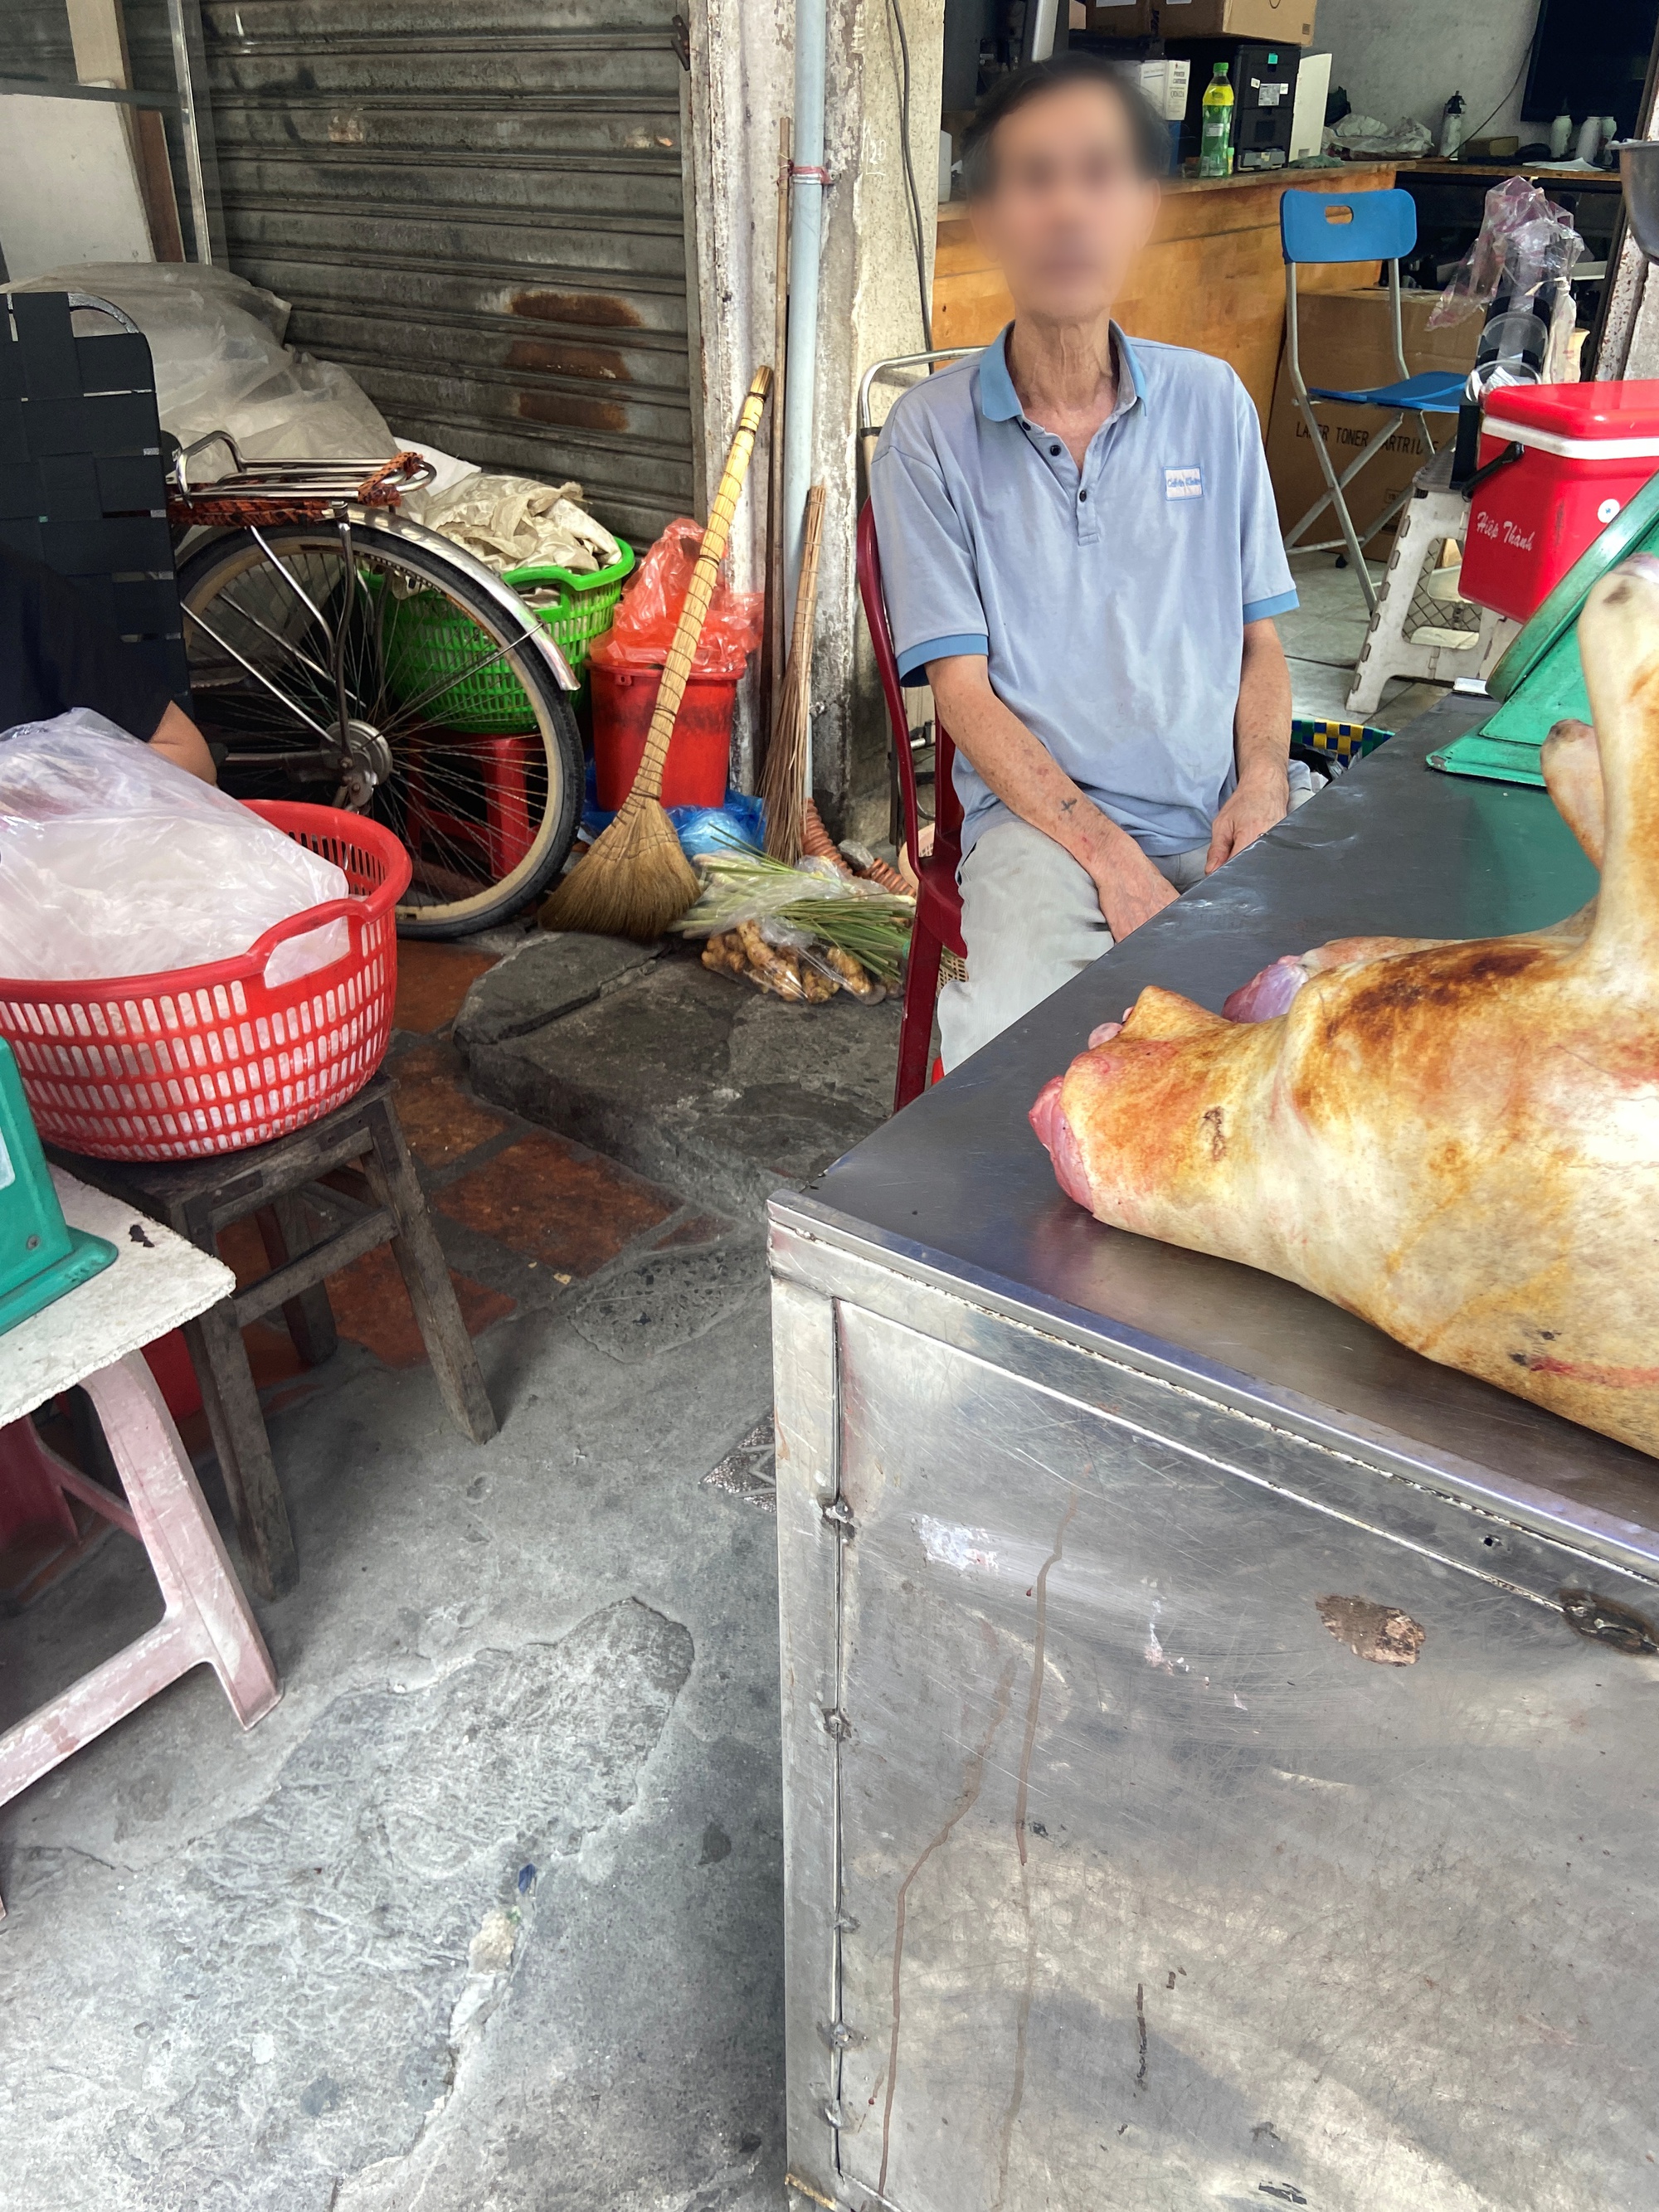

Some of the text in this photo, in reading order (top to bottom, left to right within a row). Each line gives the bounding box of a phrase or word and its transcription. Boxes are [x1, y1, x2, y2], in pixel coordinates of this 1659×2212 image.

[1296, 421, 1330, 442] LAR
[1335, 426, 1370, 447] TONER
[1503, 520, 1535, 552] Thành
